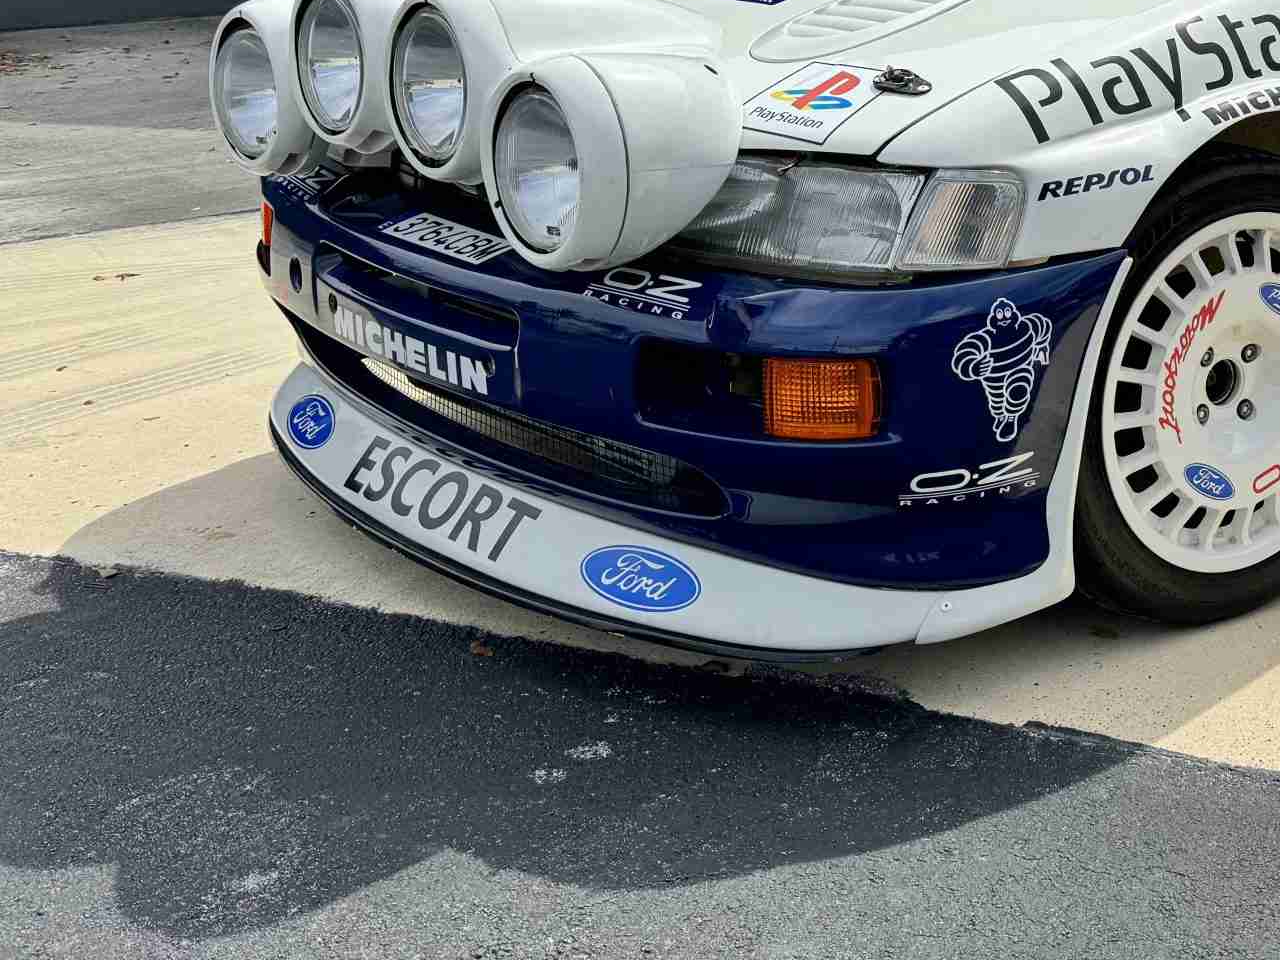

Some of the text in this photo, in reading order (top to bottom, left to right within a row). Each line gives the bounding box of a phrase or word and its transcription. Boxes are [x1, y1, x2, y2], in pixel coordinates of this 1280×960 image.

[750, 105, 824, 129] PlayStation
[1037, 164, 1155, 202] REPSOL
[583, 289, 684, 320] RACING
[332, 308, 488, 395] MICHELIN
[343, 435, 544, 562] ESCORT
[899, 479, 1037, 506] RACING
[601, 553, 676, 602] Ford
